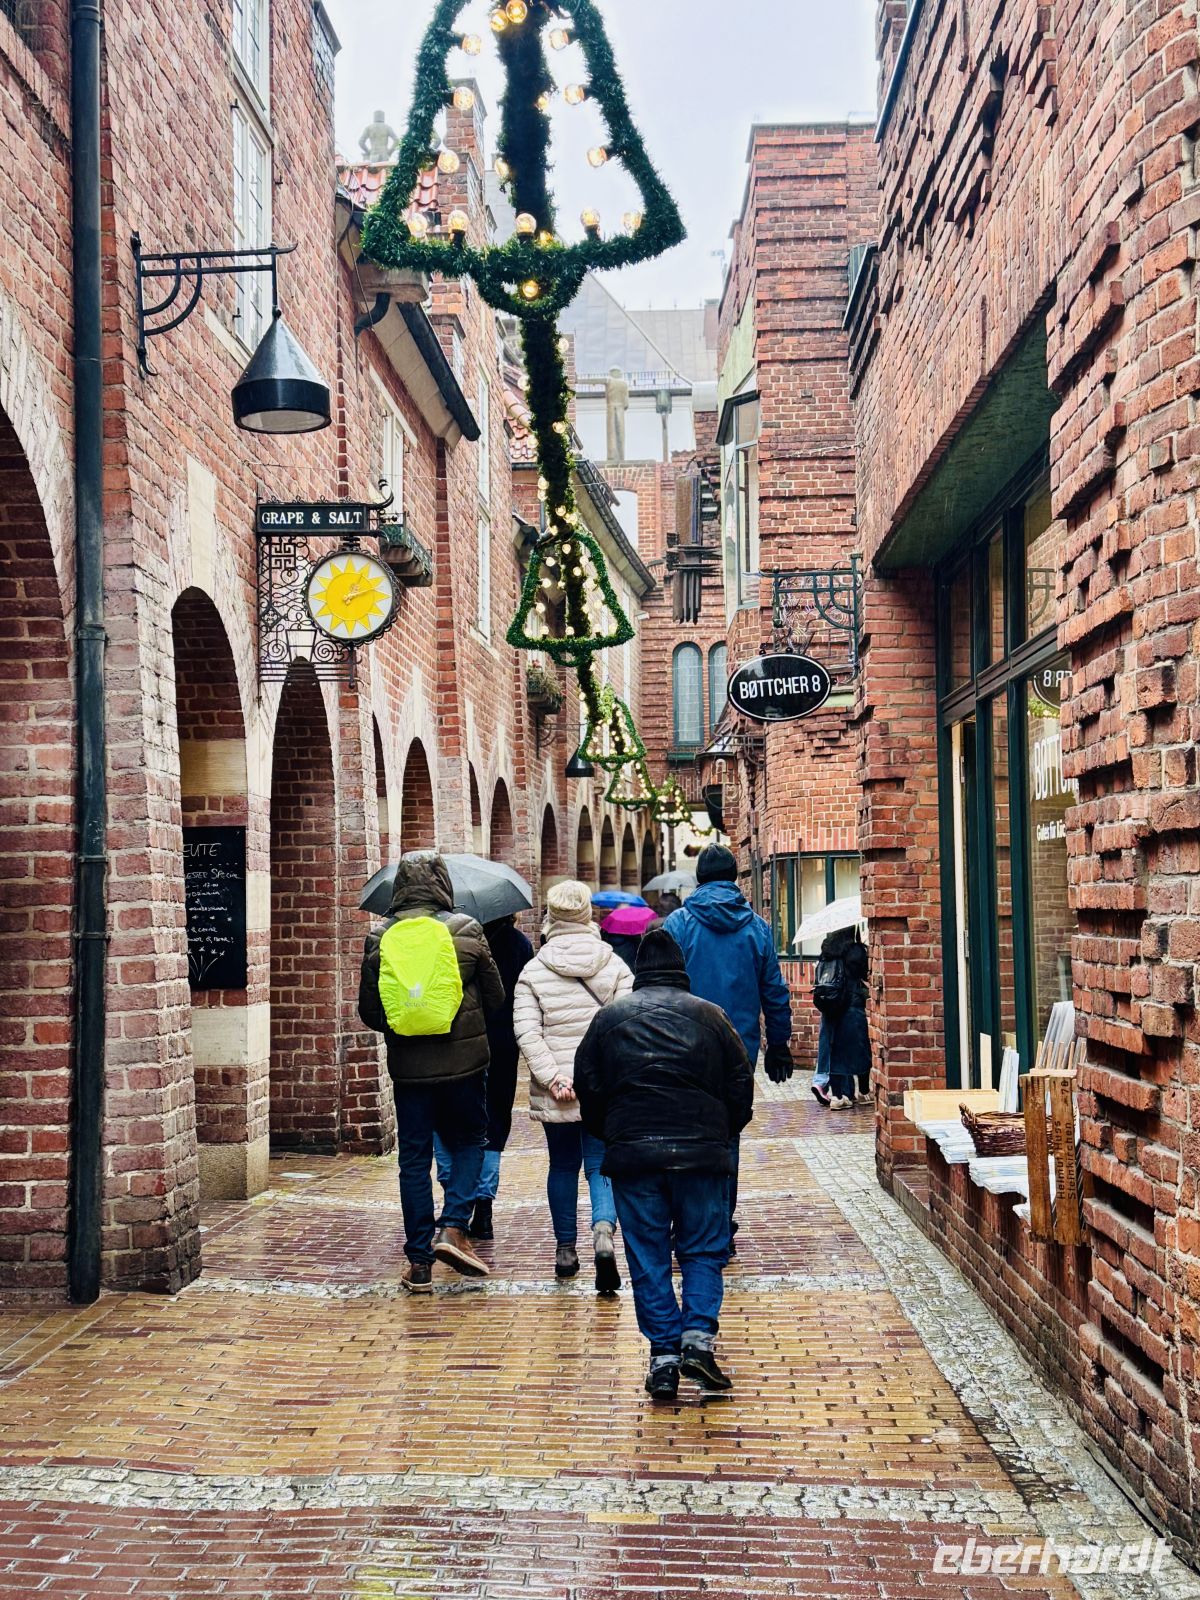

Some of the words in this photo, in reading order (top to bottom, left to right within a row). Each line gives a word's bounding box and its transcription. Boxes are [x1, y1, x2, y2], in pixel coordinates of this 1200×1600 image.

[261, 512, 304, 525] GRAPE
[311, 512, 321, 524] &
[328, 512, 362, 524] SALT
[739, 675, 809, 699] BØTTCHER
[811, 674, 821, 692] 8
[183, 842, 222, 858] EUTE
